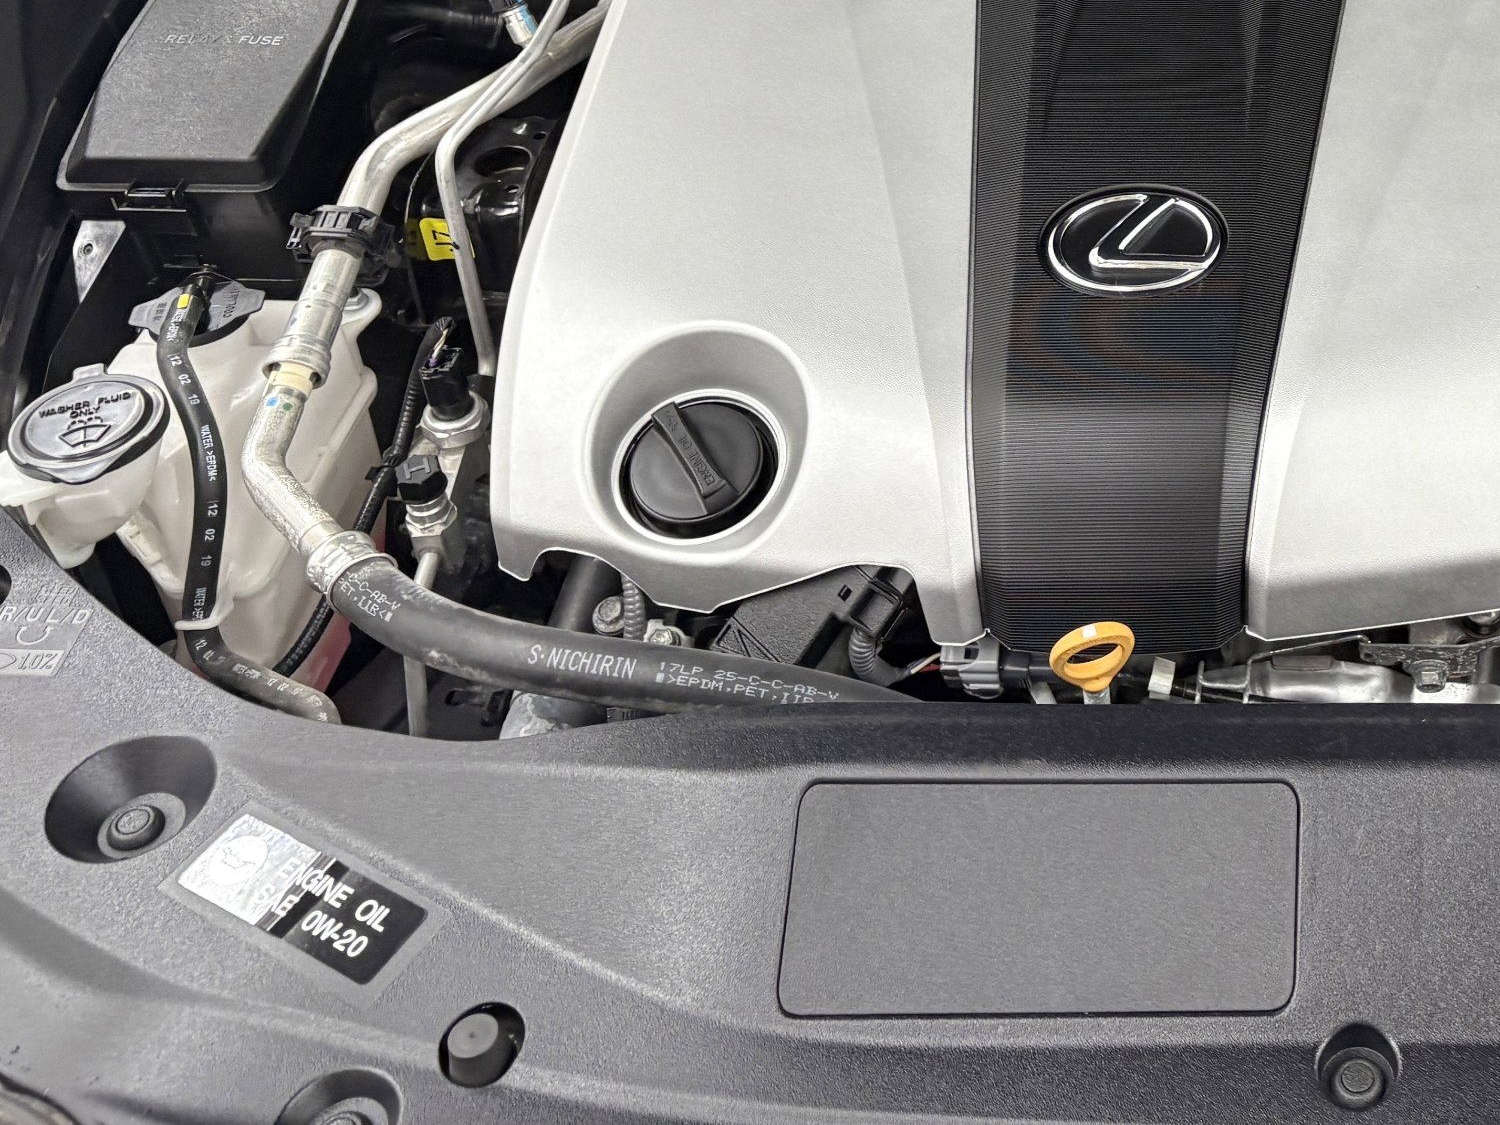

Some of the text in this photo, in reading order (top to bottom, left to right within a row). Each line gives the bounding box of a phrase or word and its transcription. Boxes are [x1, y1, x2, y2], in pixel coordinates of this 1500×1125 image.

[238, 35, 284, 46] FUSE
[38, 391, 132, 419] WASHER FLUID
[69, 405, 101, 419] ONLY
[204, 528, 216, 541] 02
[279, 857, 391, 933] ENGINE OIL
[254, 885, 370, 958] SAE 0W-20
